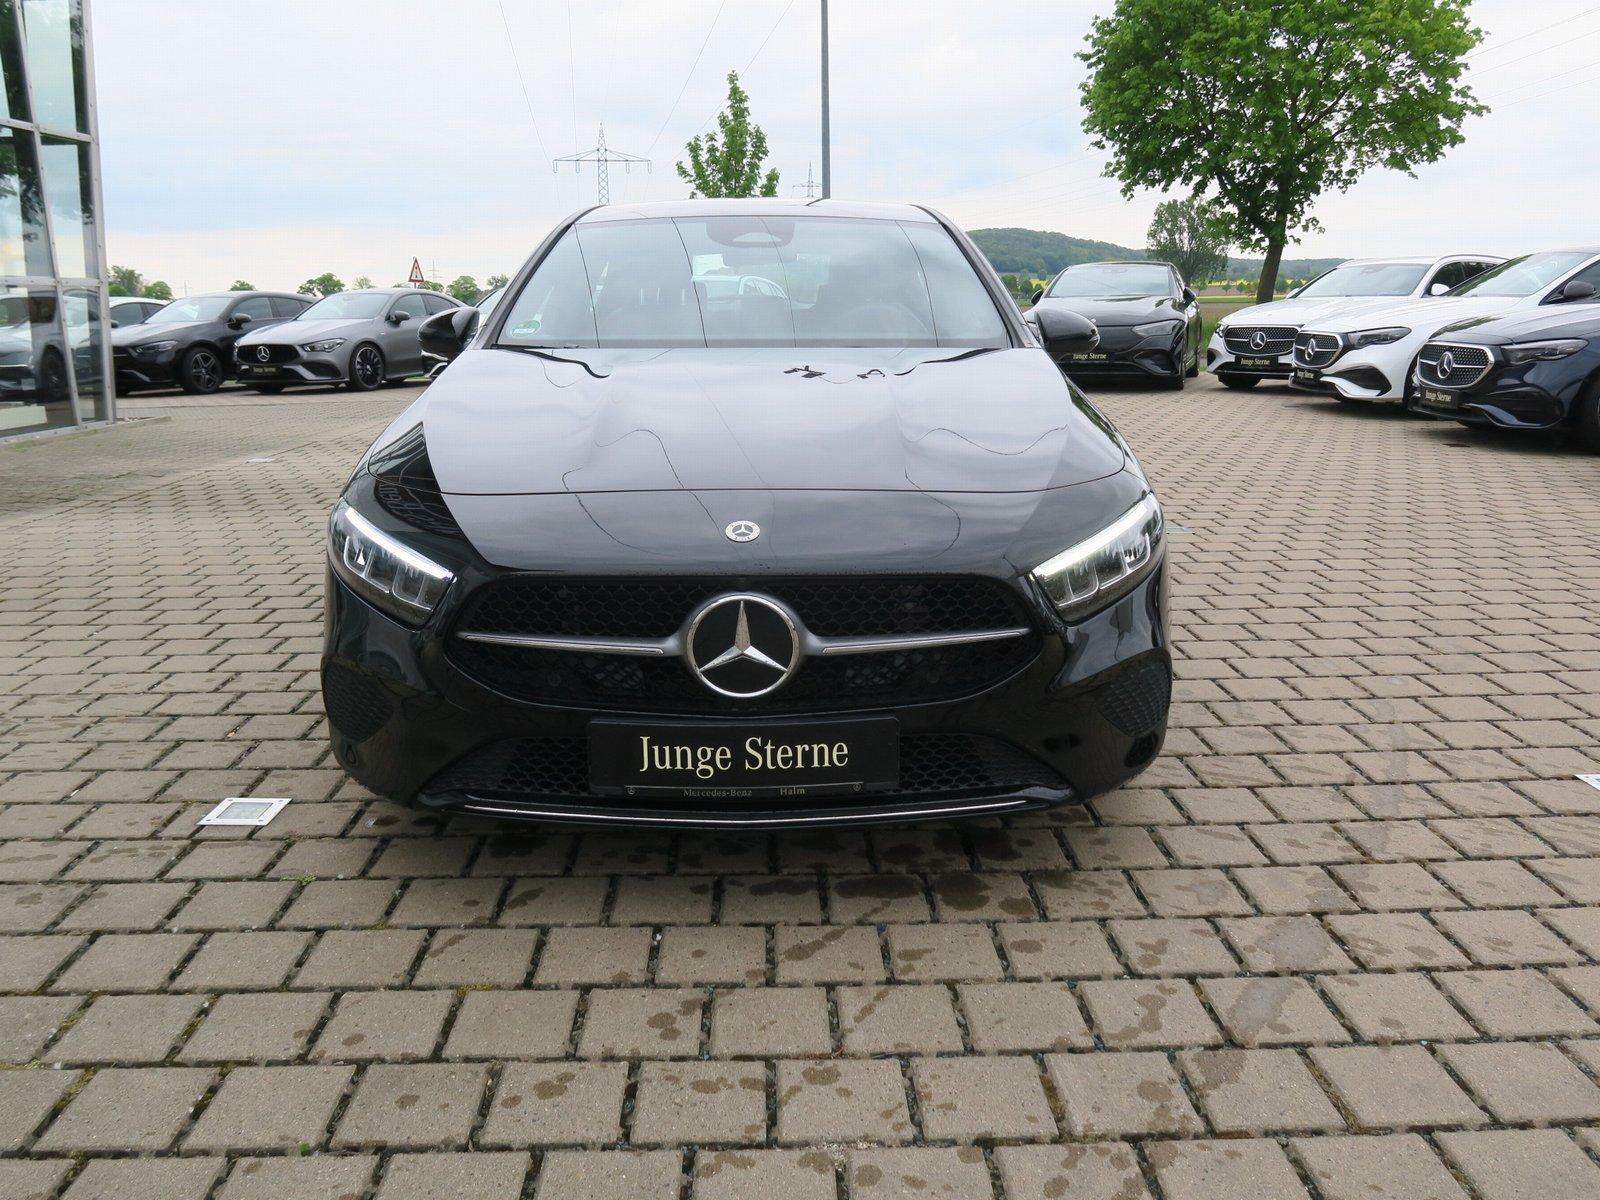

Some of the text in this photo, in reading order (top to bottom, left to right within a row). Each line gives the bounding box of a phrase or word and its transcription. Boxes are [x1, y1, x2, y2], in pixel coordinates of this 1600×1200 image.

[639, 736, 849, 779] Junge Sterne
[683, 786, 806, 797] Mercedes-Benz Halm
